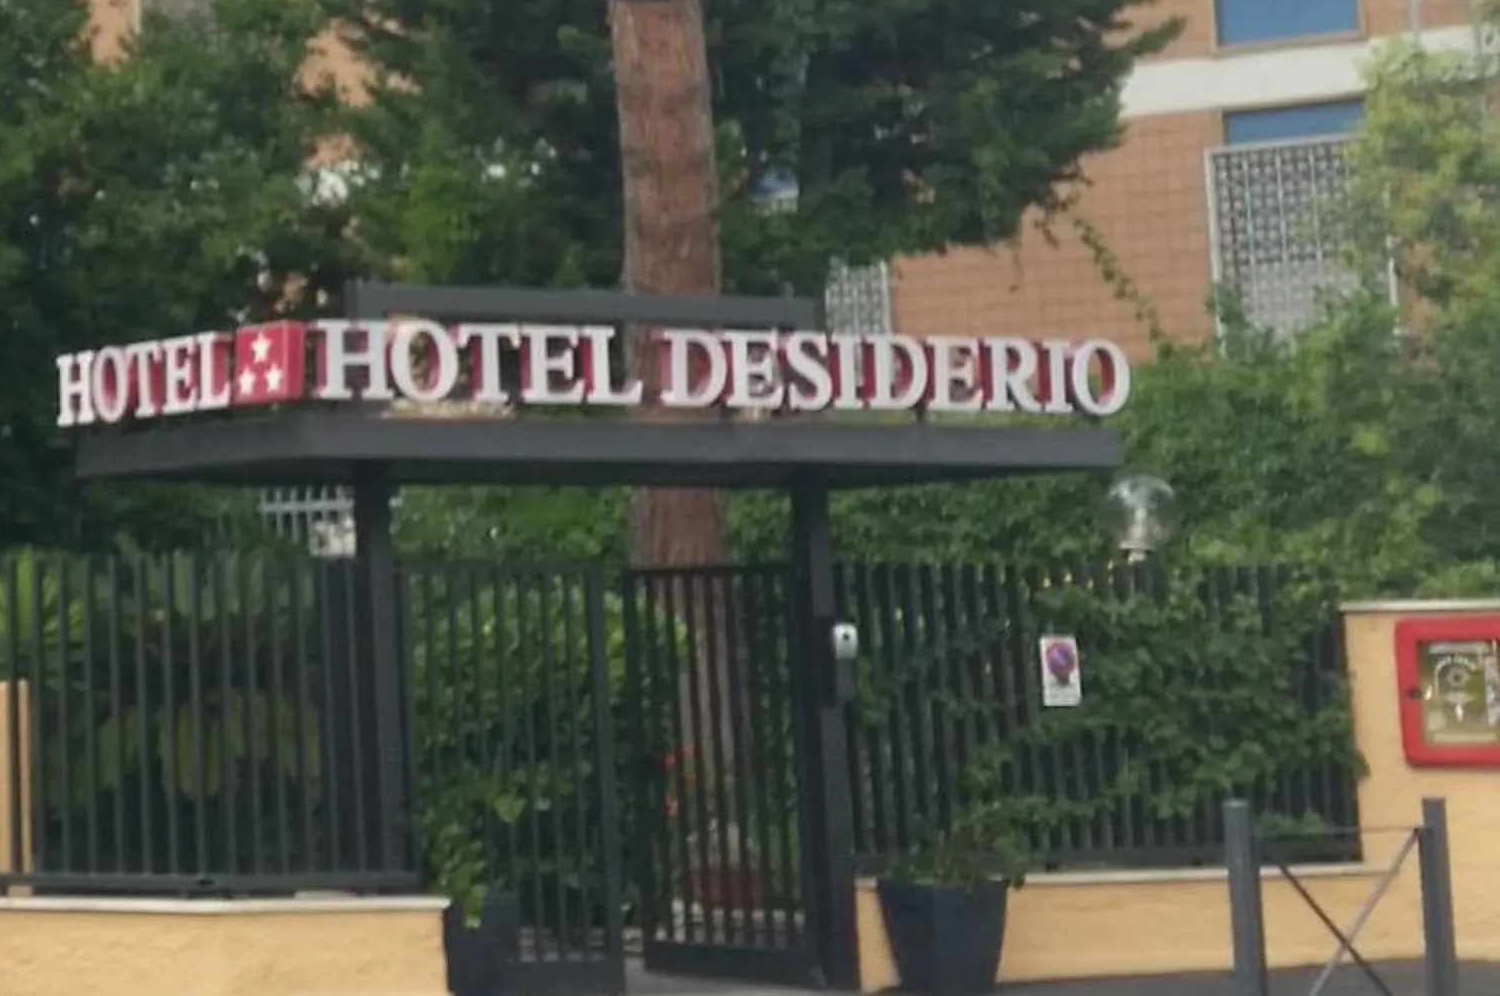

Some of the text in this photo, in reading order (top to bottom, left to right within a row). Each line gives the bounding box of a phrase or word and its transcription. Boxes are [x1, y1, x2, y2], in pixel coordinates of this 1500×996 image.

[55, 330, 232, 428] HOTEL
[315, 319, 1133, 417] HOTEL DESIDERIO
